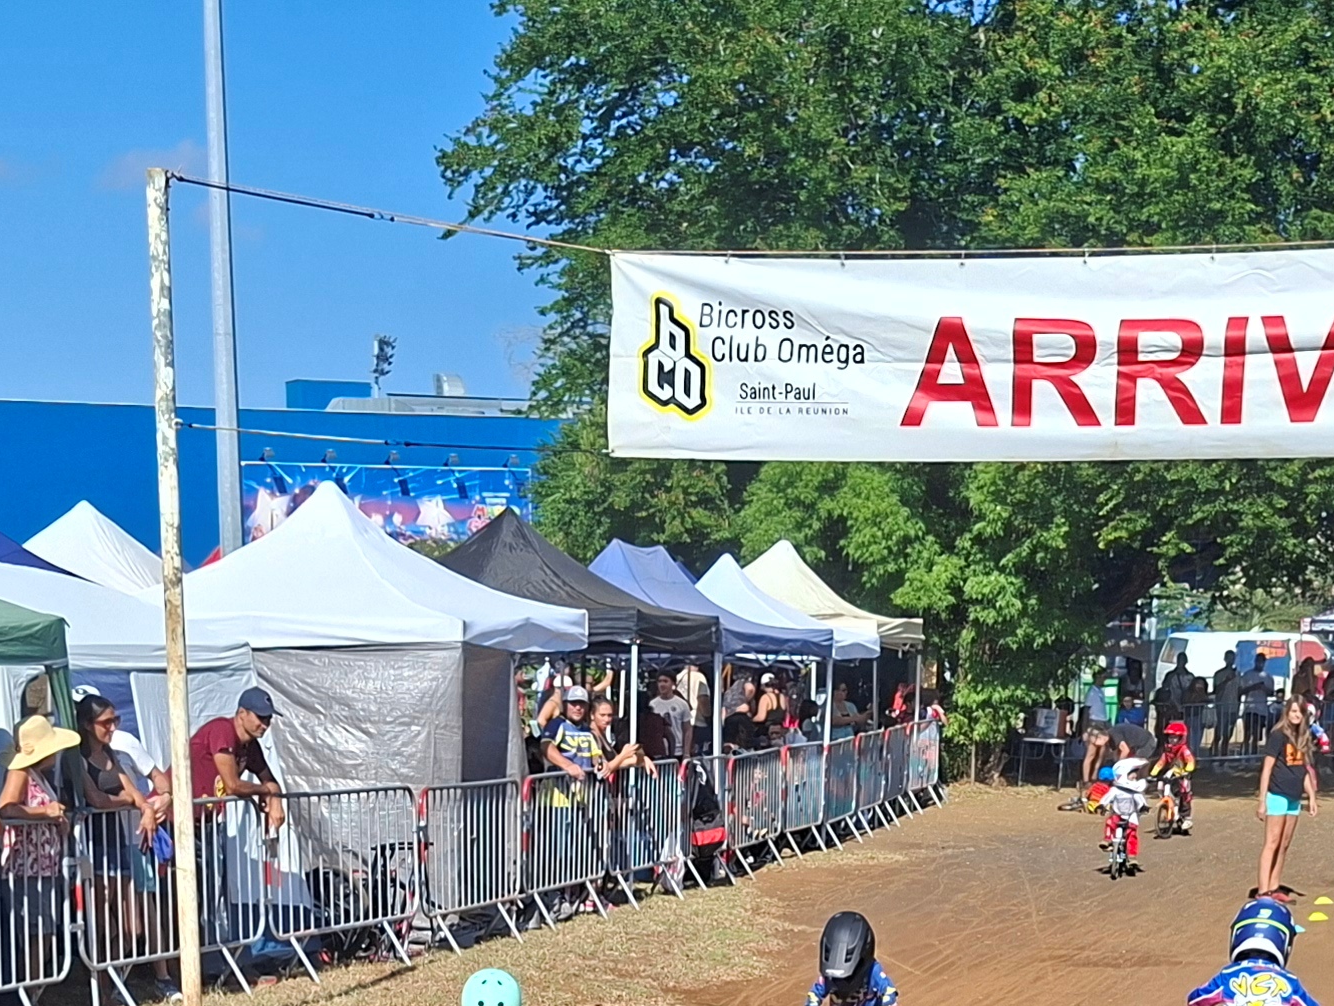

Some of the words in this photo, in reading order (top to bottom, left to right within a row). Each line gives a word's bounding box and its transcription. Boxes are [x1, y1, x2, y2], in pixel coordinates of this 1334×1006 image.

[699, 301, 795, 330] Bicross
[711, 335, 768, 363] Club
[777, 336, 866, 370] Oméga
[739, 381, 817, 400] Saint-Paul
[759, 407, 772, 415] DE
[779, 407, 792, 415] LA
